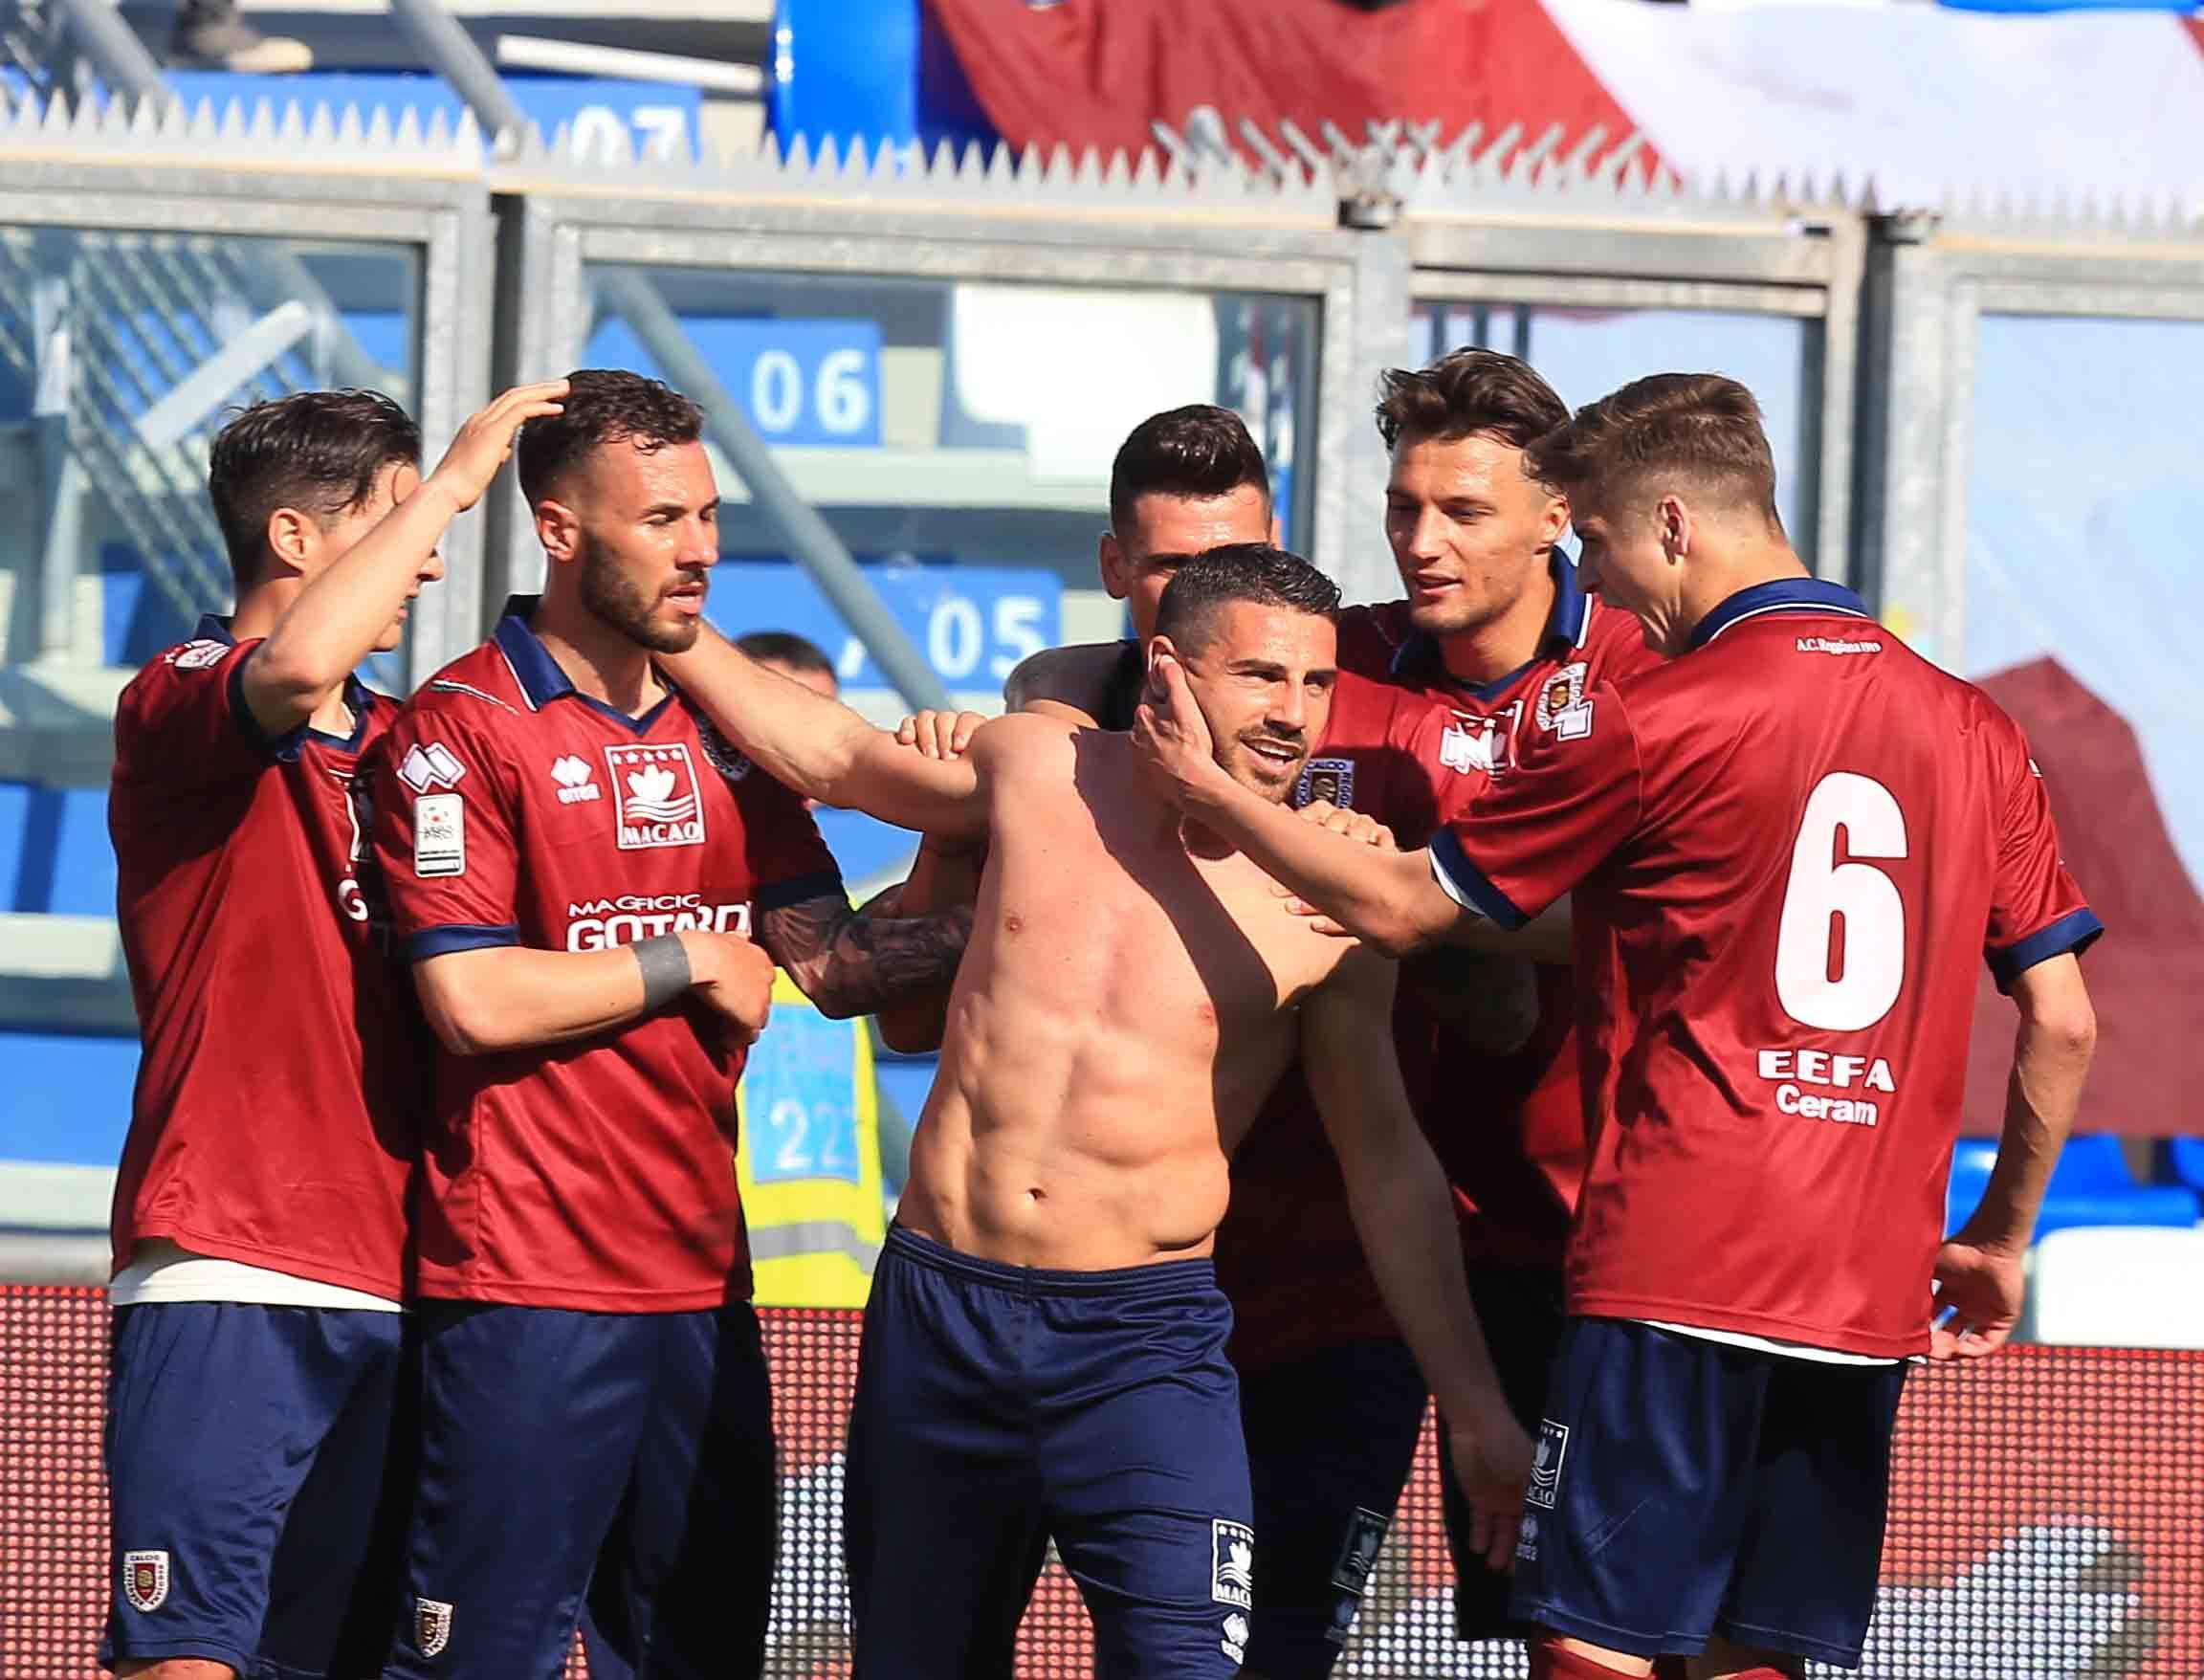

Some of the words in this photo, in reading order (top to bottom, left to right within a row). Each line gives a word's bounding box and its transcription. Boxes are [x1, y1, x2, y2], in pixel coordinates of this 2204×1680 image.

[572, 106, 684, 166] 07
[753, 350, 871, 433] 06
[929, 597, 1045, 679] 05
[623, 821, 700, 845] MACAO
[1775, 771, 1908, 1032] 6
[1757, 1049, 1896, 1093] EEFA
[1775, 1083, 1878, 1126] Ceram
